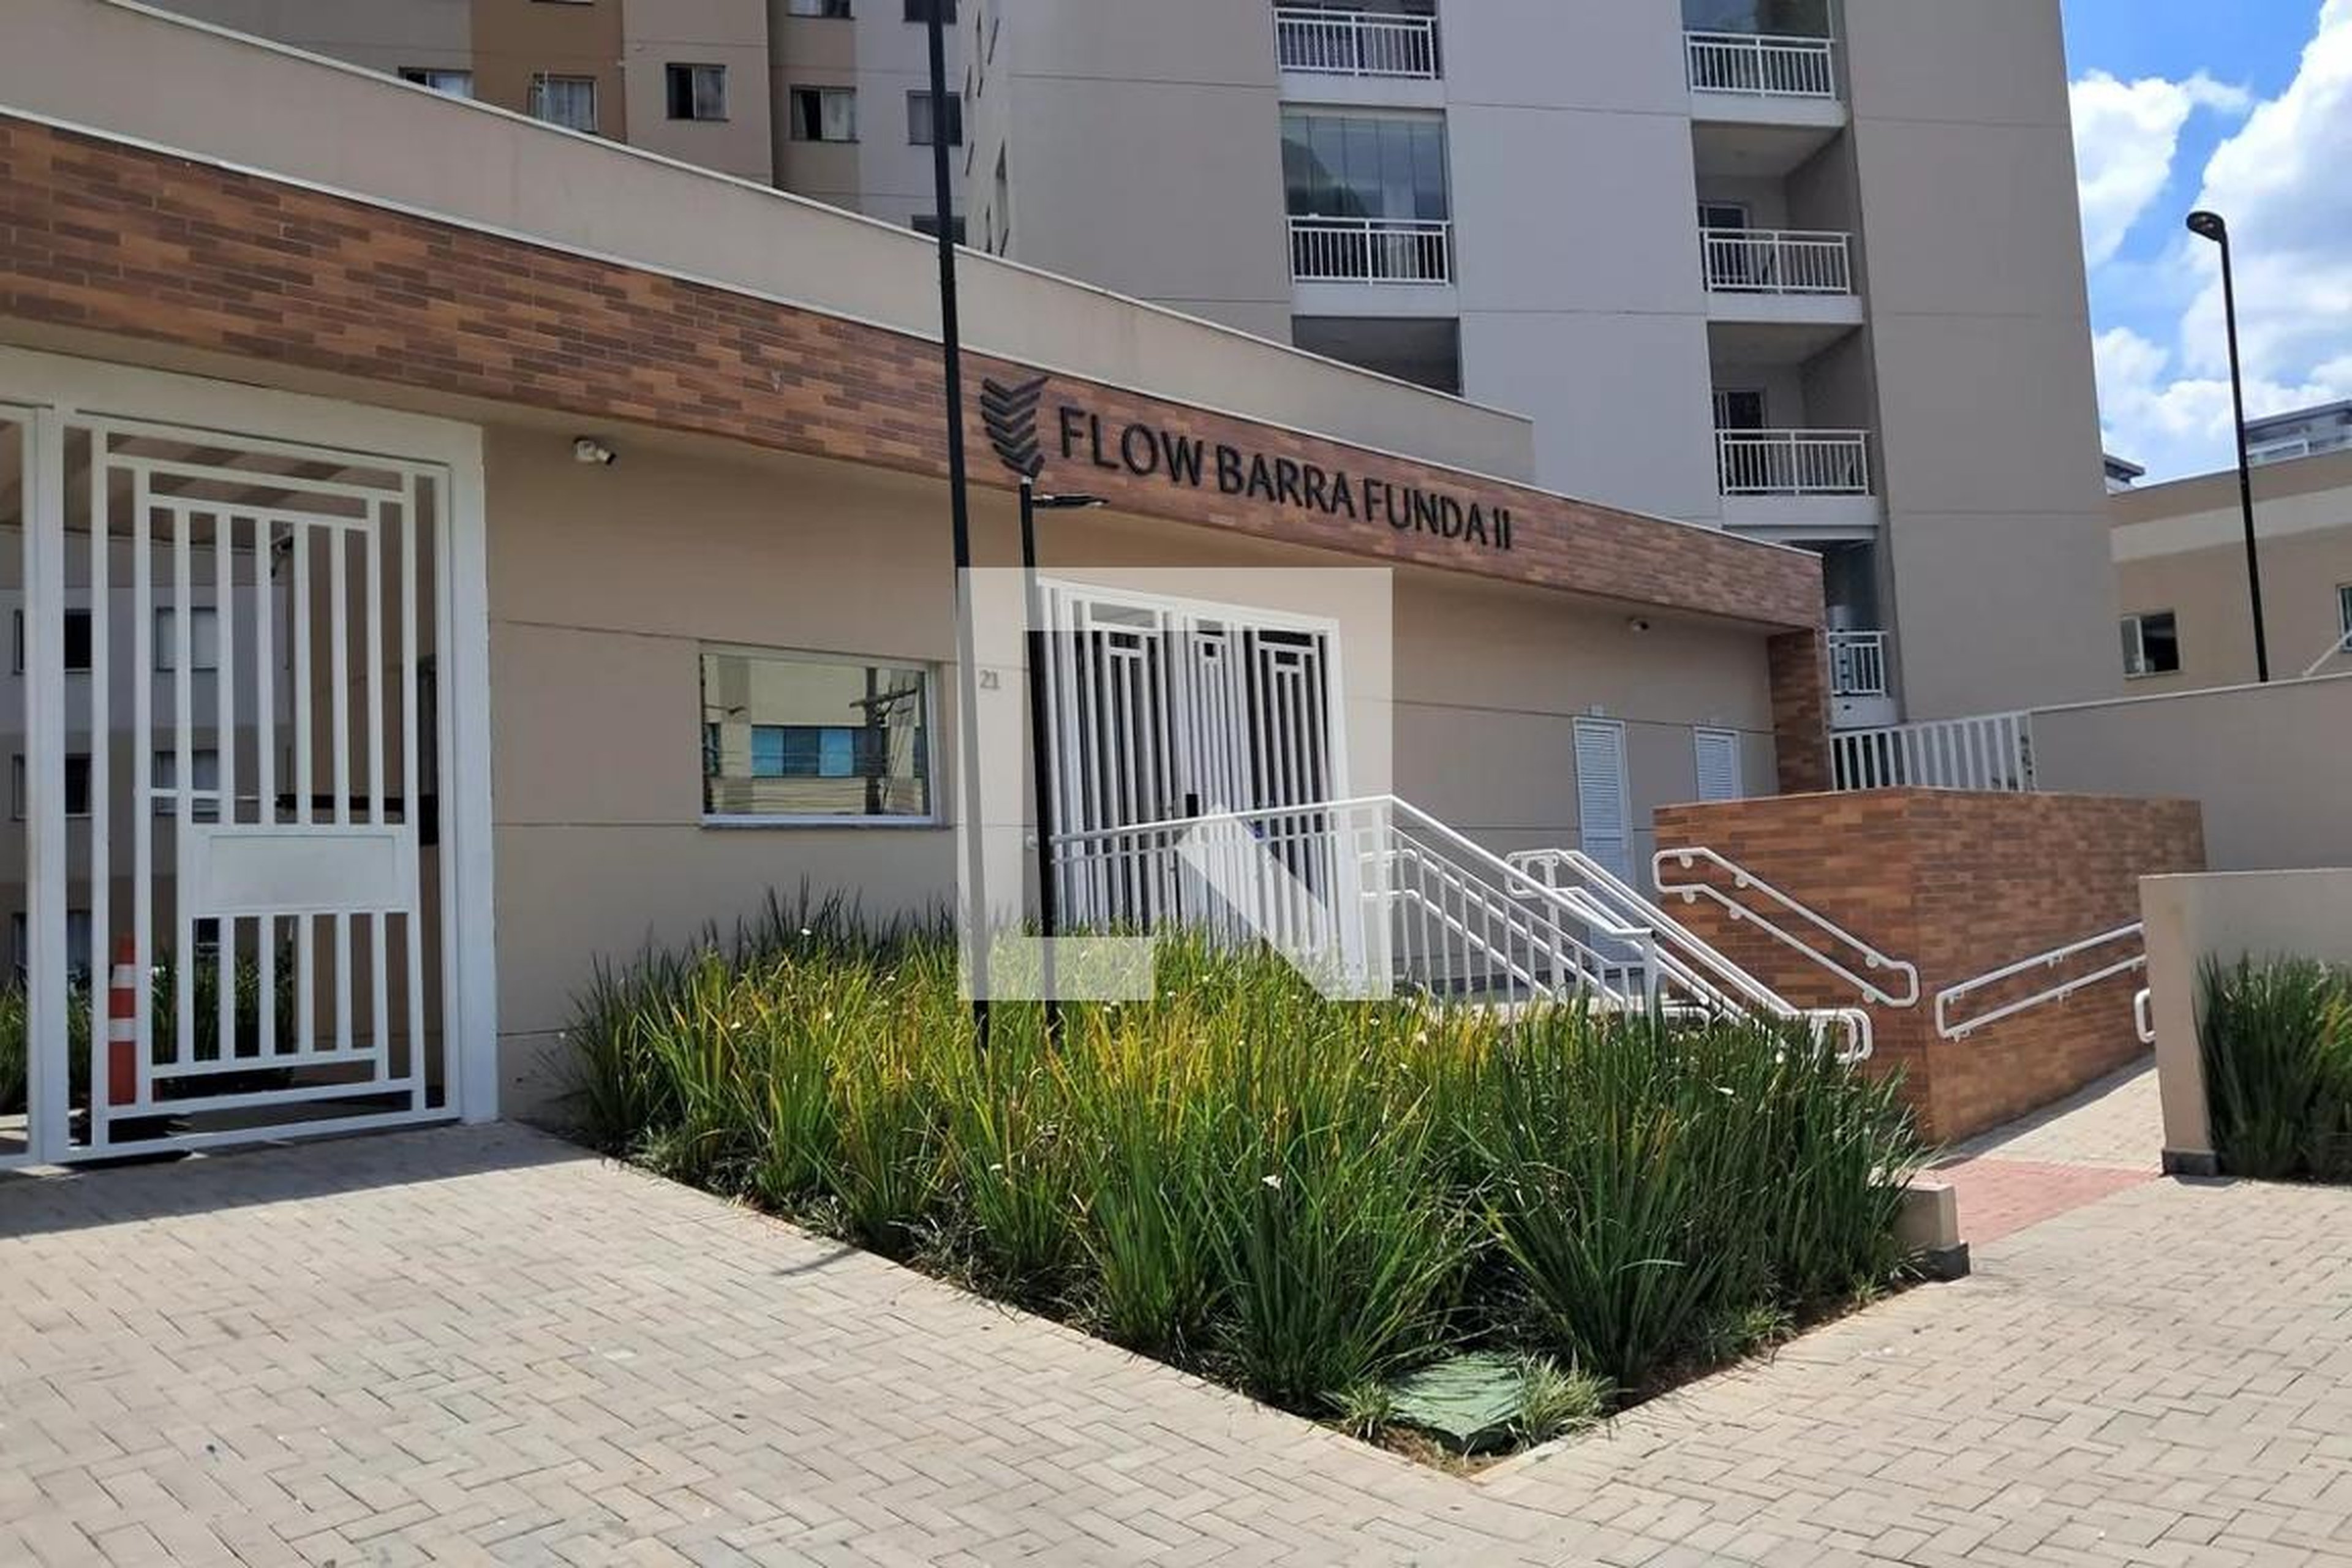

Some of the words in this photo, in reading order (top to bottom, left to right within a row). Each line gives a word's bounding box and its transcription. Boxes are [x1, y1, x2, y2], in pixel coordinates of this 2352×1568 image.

[1059, 405, 1204, 486] FLOW
[1216, 445, 1356, 518] BARRA
[1363, 478, 1488, 546] FUNDA
[1492, 508, 1512, 550] II
[979, 669, 1000, 690] 21
